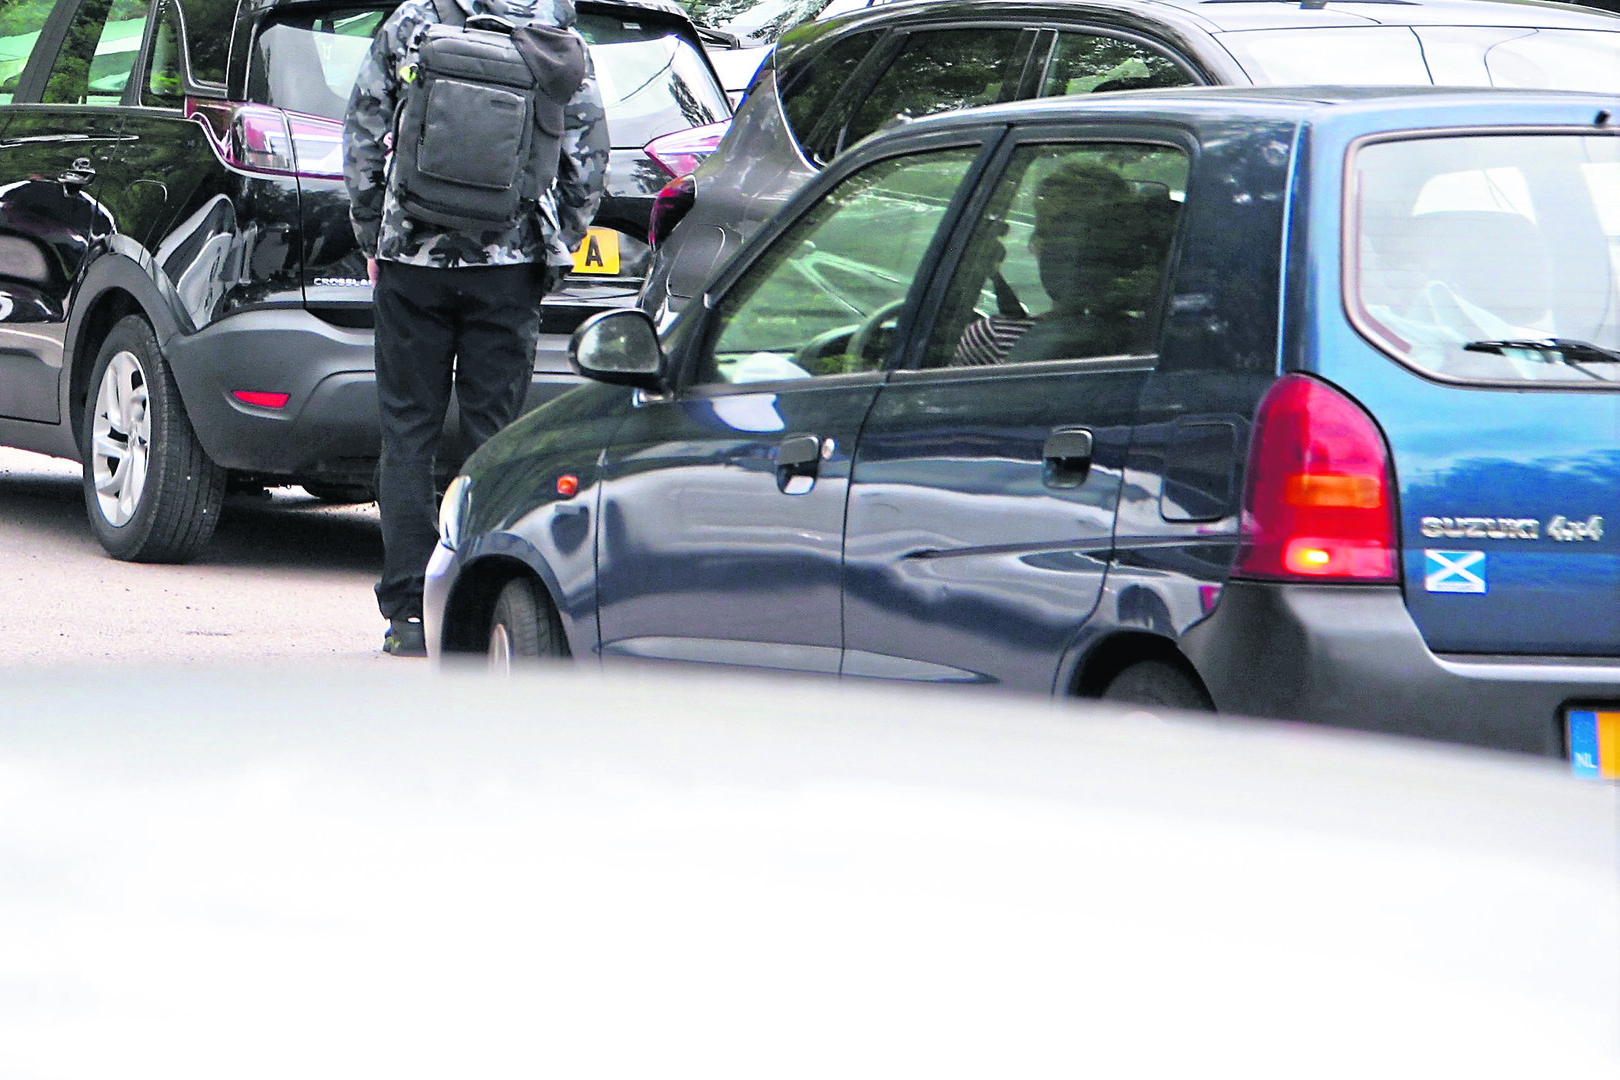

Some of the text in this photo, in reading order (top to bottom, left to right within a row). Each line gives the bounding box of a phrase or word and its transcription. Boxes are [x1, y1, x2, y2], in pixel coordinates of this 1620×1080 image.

[585, 235, 604, 267] A
[1420, 514, 1604, 542] SUZUKI 4x4
[1574, 751, 1597, 769] NL
